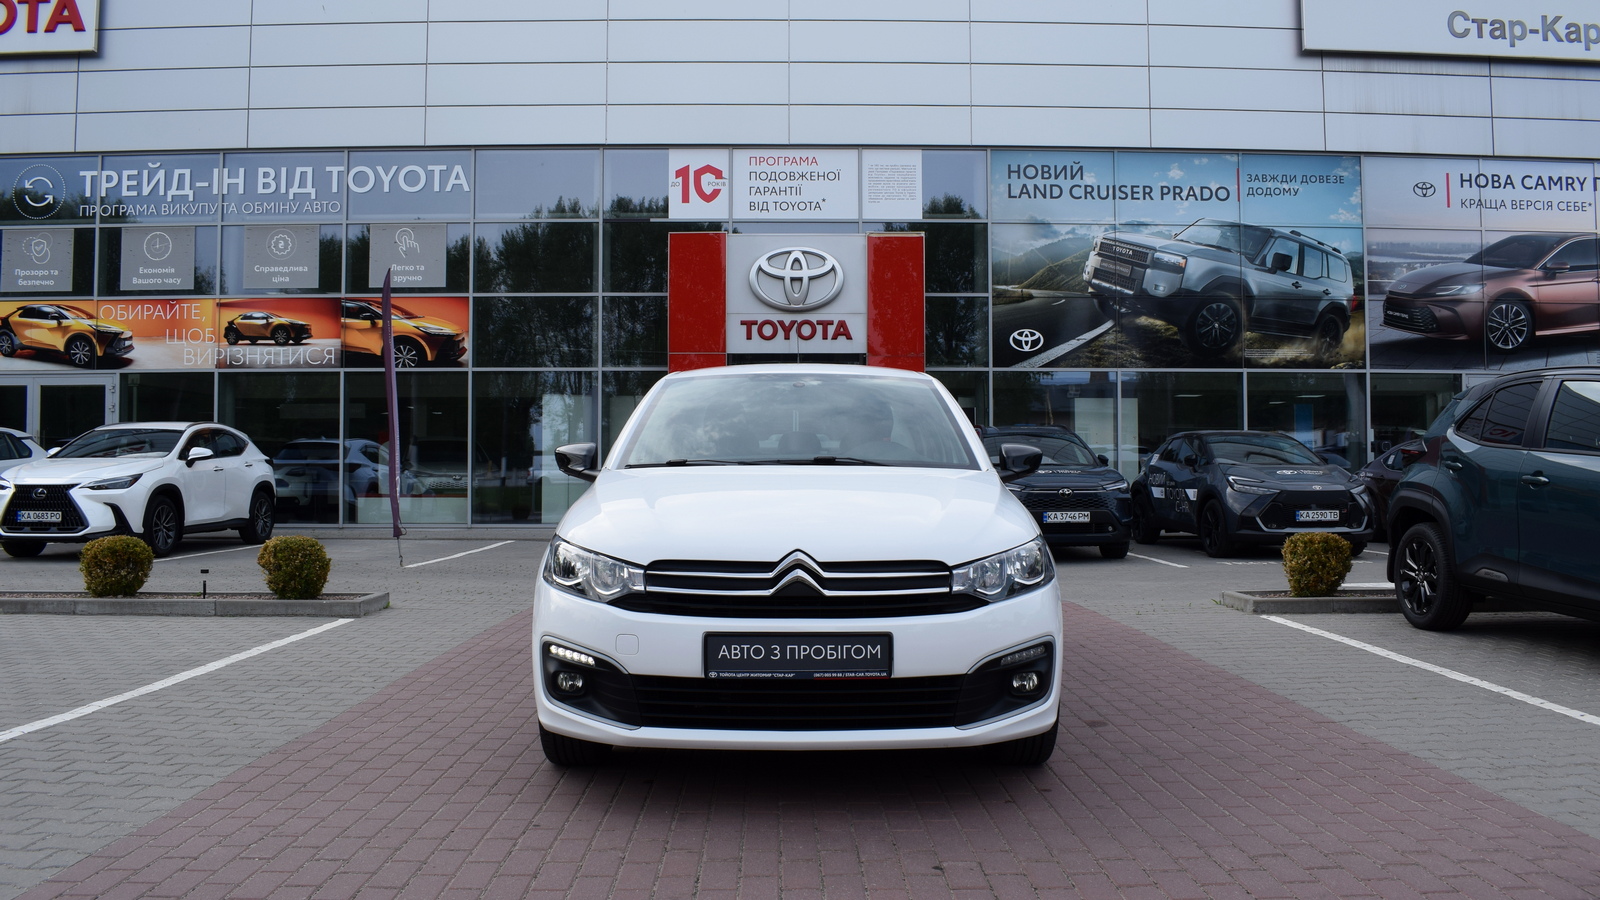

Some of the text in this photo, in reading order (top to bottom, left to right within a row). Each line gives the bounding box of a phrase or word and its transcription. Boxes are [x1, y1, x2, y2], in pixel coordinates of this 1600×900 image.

[1447, 10, 1600, 51] Стар-Кар
[749, 156, 818, 166] ПРОГРАМА
[749, 168, 841, 183] ПОДОВЖЕНОЇ
[1007, 161, 1084, 180] НОВИЙ
[79, 162, 470, 202] ТРЕЙД-ІН ВІД TOYOTA
[1246, 173, 1345, 186] ЗАВЖДИ ДОВЕЗЕ
[1460, 173, 1515, 190] НОВА
[1521, 174, 1588, 192] CAMRY
[749, 183, 802, 196] ГАРАНТІЇ
[1007, 183, 1231, 202] LAND CRUISER PRADO
[1246, 186, 1300, 198] ДОДОМУ
[79, 200, 341, 217] ПРОГРАМА ВИКУПУ ТА ОБМІНУ АВТО
[749, 201, 770, 213] ВІД
[1460, 198, 1507, 211] КРАЩА
[1511, 200, 1553, 211] ВЕРСІЯ
[1112, 246, 1133, 255] TOYOTA
[15, 269, 49, 278] Прозоро
[139, 266, 175, 274] Економія
[254, 264, 308, 273] Справедлива
[391, 264, 414, 272] Легко
[18, 278, 54, 286] безпечно
[132, 277, 181, 285] Вашого часу
[272, 275, 290, 283] ціна
[393, 274, 423, 282] зручно
[100, 300, 206, 322] ОБИРАЙТЕ,
[740, 319, 853, 341] TOYOTA
[166, 327, 215, 348] ЩОБ
[183, 347, 335, 365] ВИРІЗНЯТИСЯ
[1311, 511, 1328, 519] 2590
[718, 644, 881, 659] АВТО З ПРОБІГОМ
